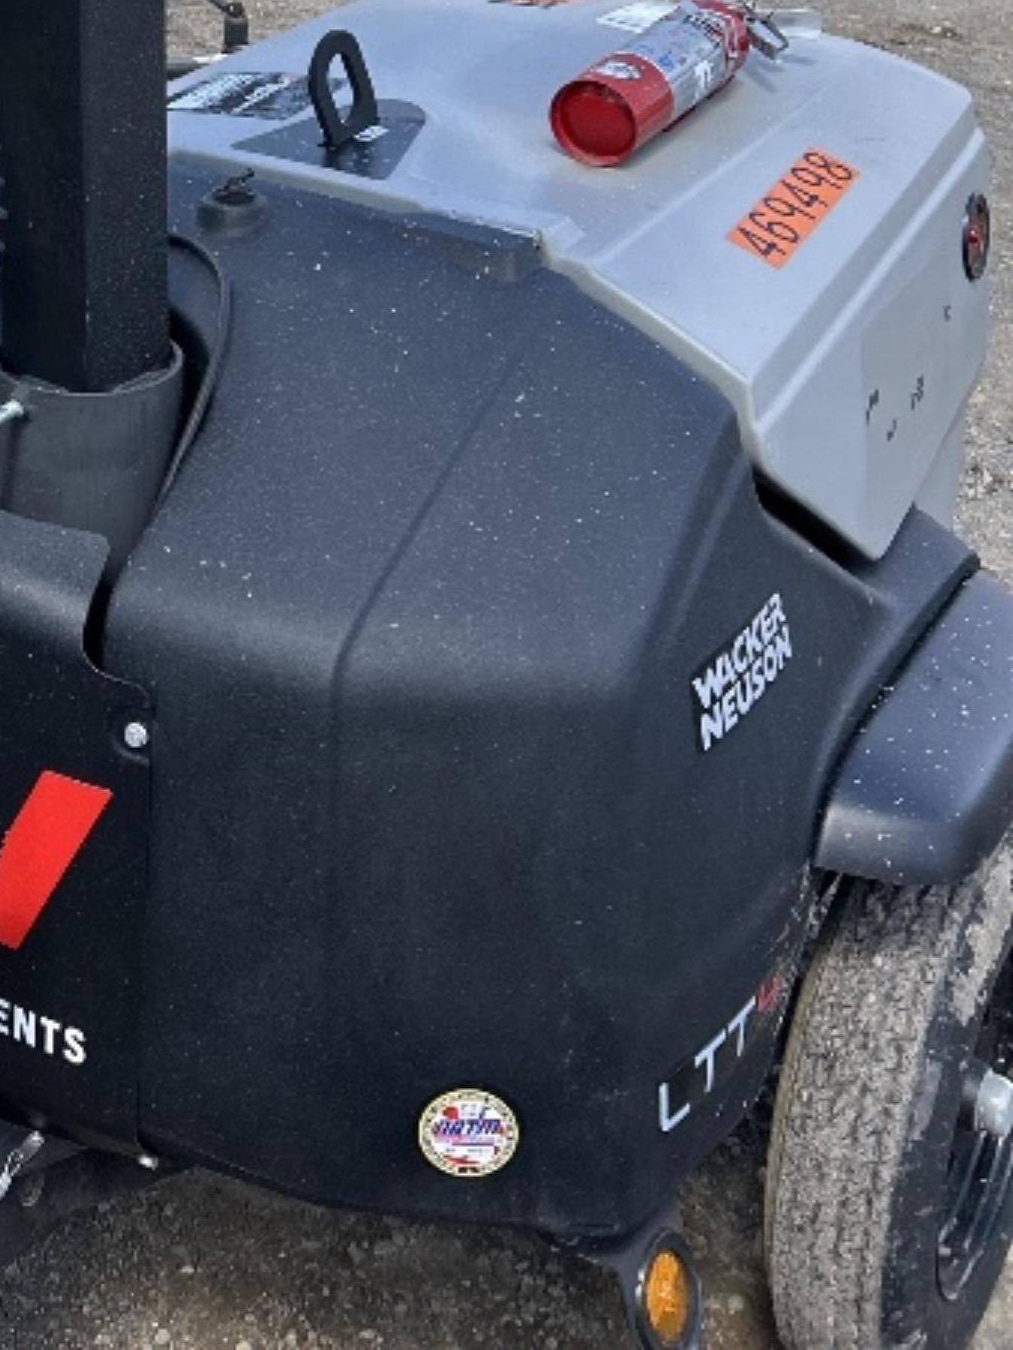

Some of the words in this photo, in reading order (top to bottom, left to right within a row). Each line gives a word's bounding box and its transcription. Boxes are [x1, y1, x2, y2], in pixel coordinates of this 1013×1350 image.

[737, 152, 853, 257] 469498
[692, 593, 786, 709] WACKER
[700, 624, 792, 751] NEUSON
